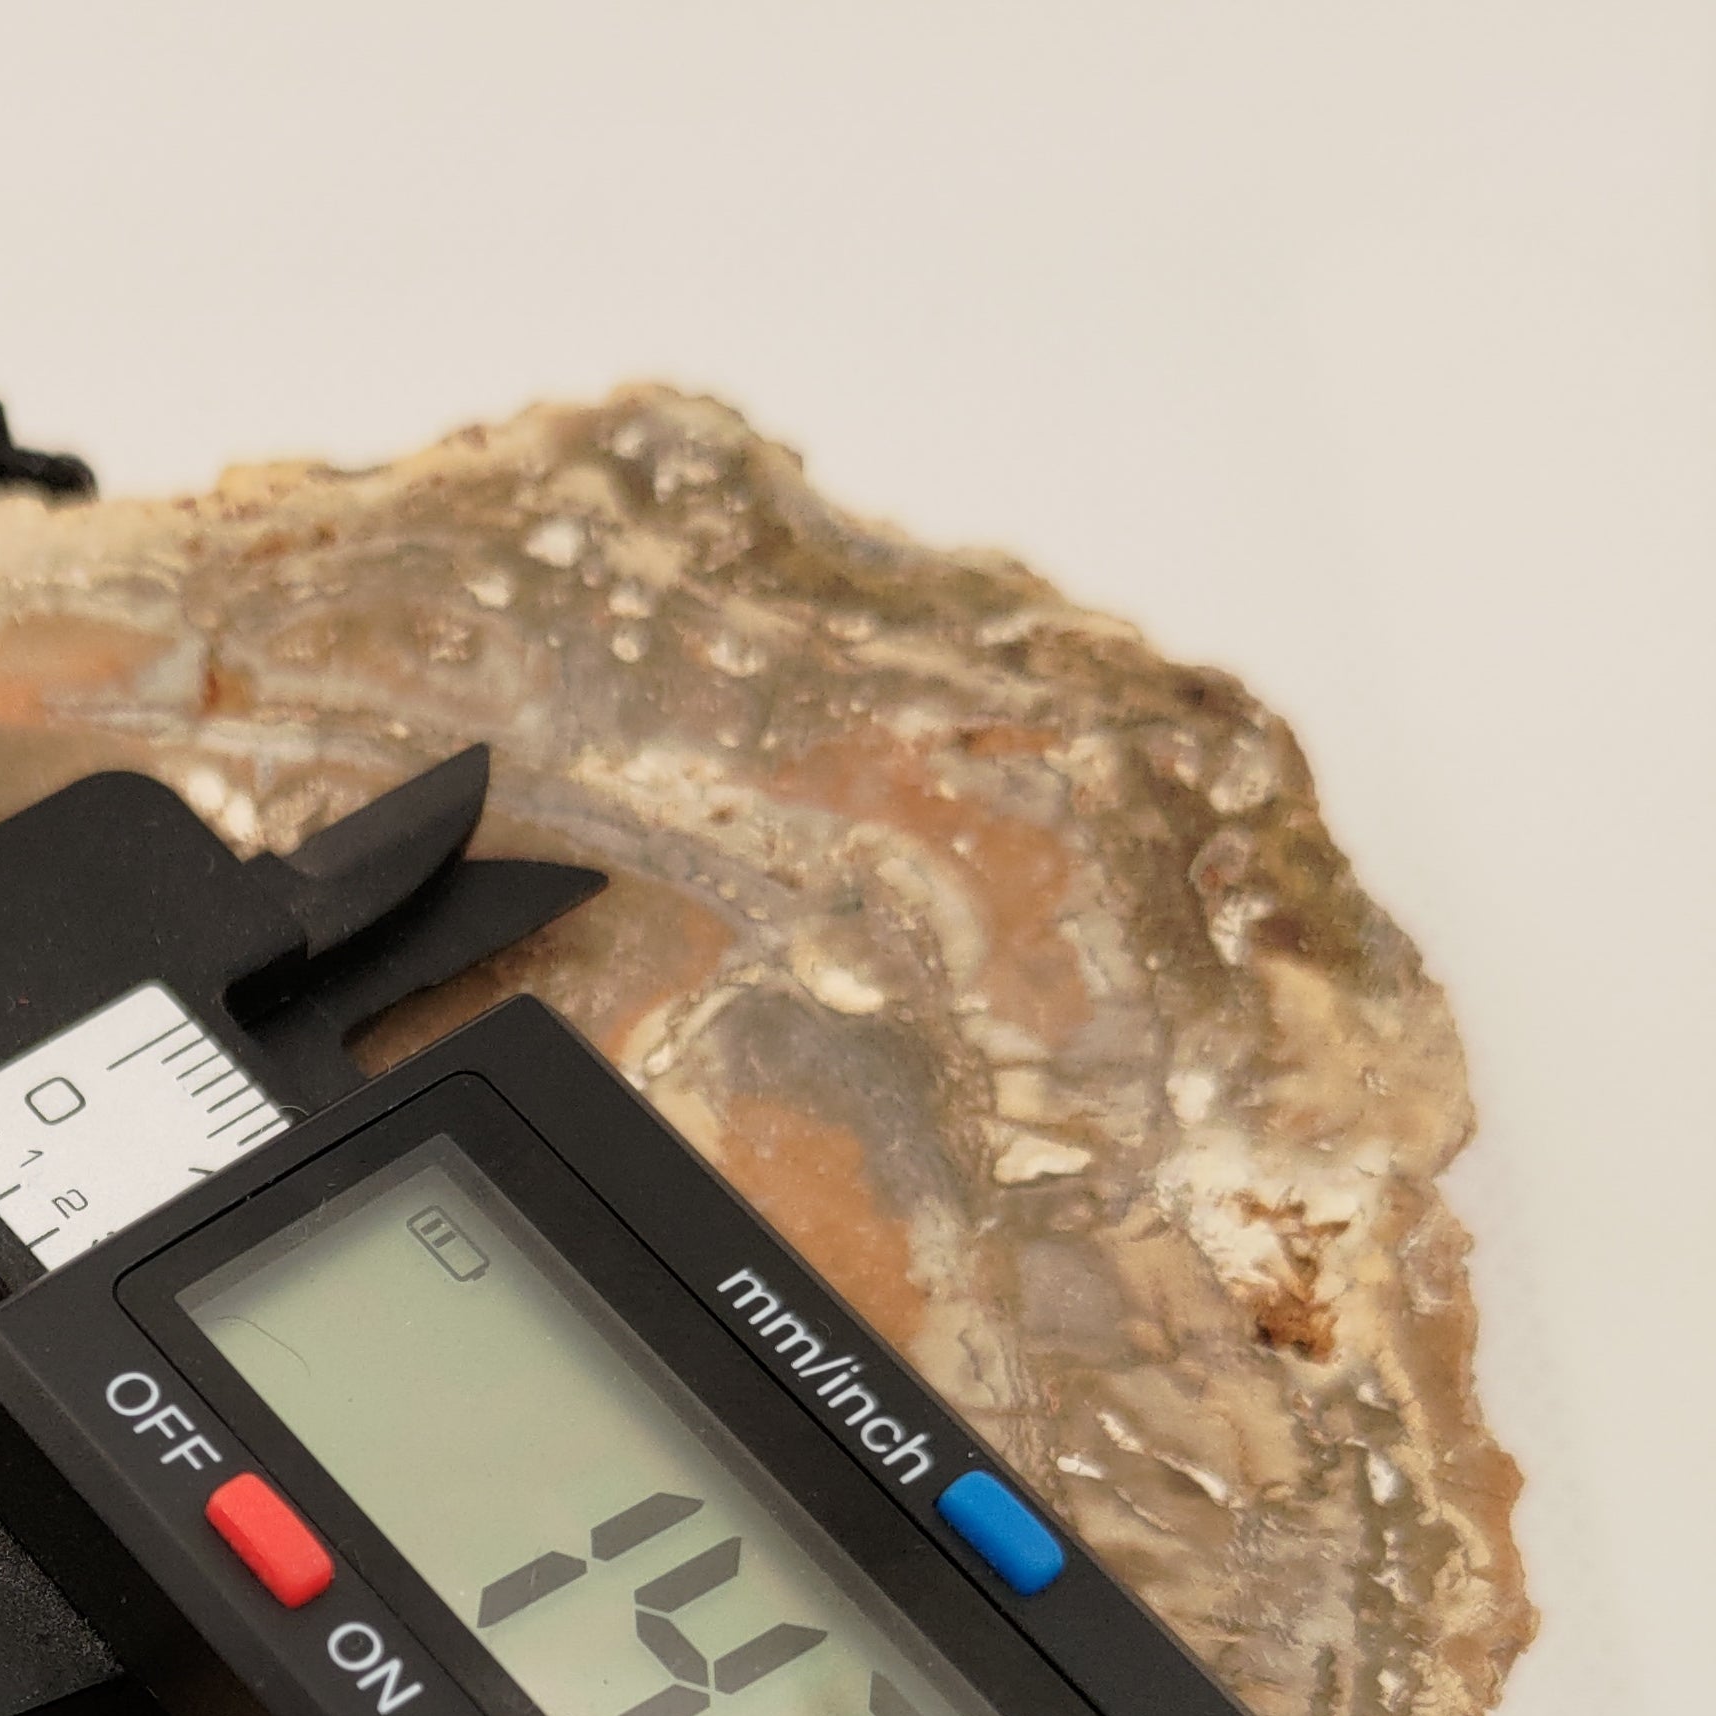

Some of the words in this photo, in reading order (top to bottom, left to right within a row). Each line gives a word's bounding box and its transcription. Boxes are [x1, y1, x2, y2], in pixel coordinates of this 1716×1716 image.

[25, 1077, 86, 1125] 0
[20, 1149, 44, 1168] 1
[51, 1188, 89, 1220] 2
[104, 1370, 222, 1474] OFF
[716, 1267, 935, 1485] mm/inch
[325, 1621, 425, 1716] ON
